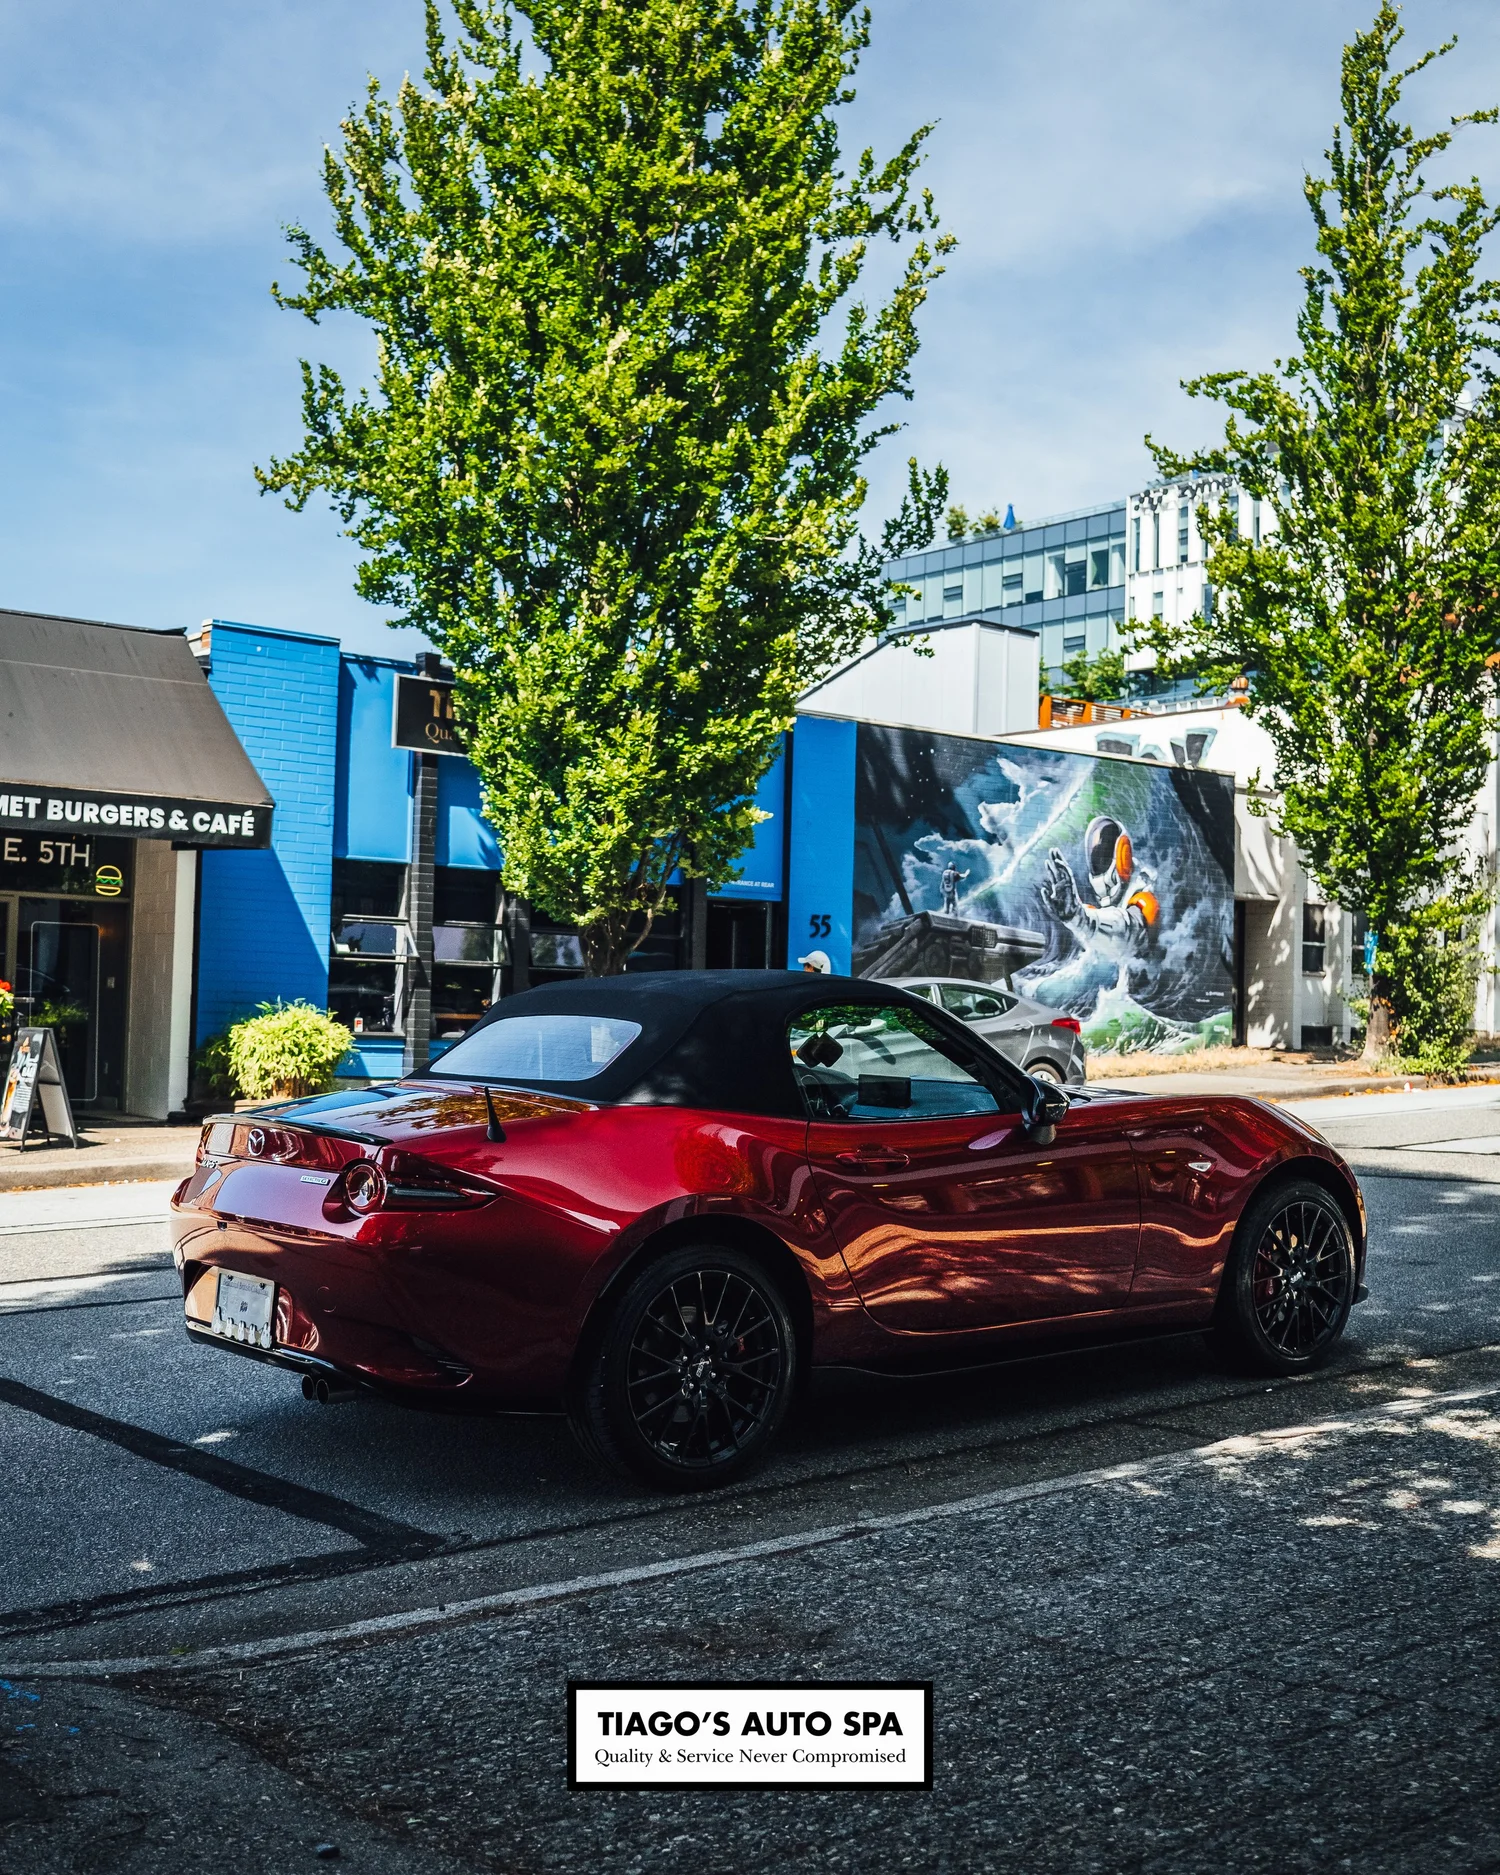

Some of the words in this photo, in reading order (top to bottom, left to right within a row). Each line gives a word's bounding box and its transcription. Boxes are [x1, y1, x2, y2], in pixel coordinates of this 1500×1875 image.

[47, 799, 165, 829] BURGERS
[168, 809, 189, 831] &
[192, 809, 255, 837] CAFÉ
[4, 837, 27, 862] E.
[39, 841, 90, 867] 5TH
[809, 914, 832, 938] 55
